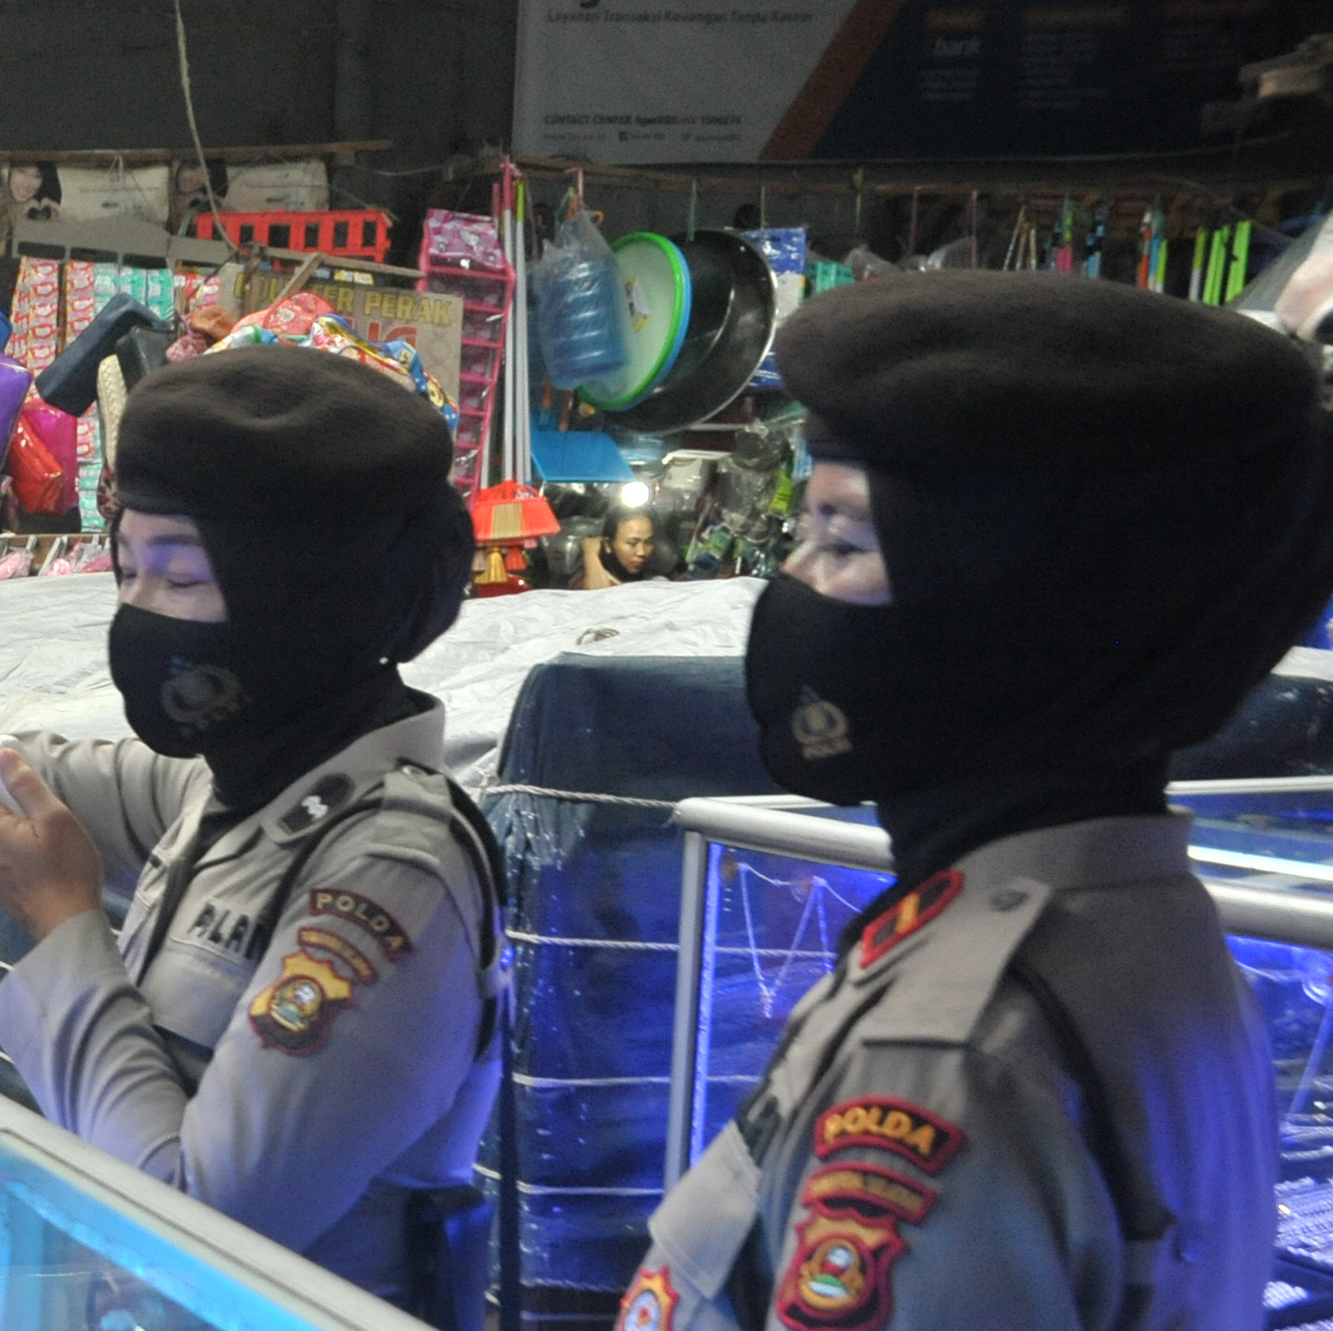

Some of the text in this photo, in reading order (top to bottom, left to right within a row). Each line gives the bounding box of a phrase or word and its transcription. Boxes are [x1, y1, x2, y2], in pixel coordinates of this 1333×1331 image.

[363, 289, 453, 326] PERAK
[315, 892, 405, 953] POLDA
[823, 1105, 937, 1158] POLDA
